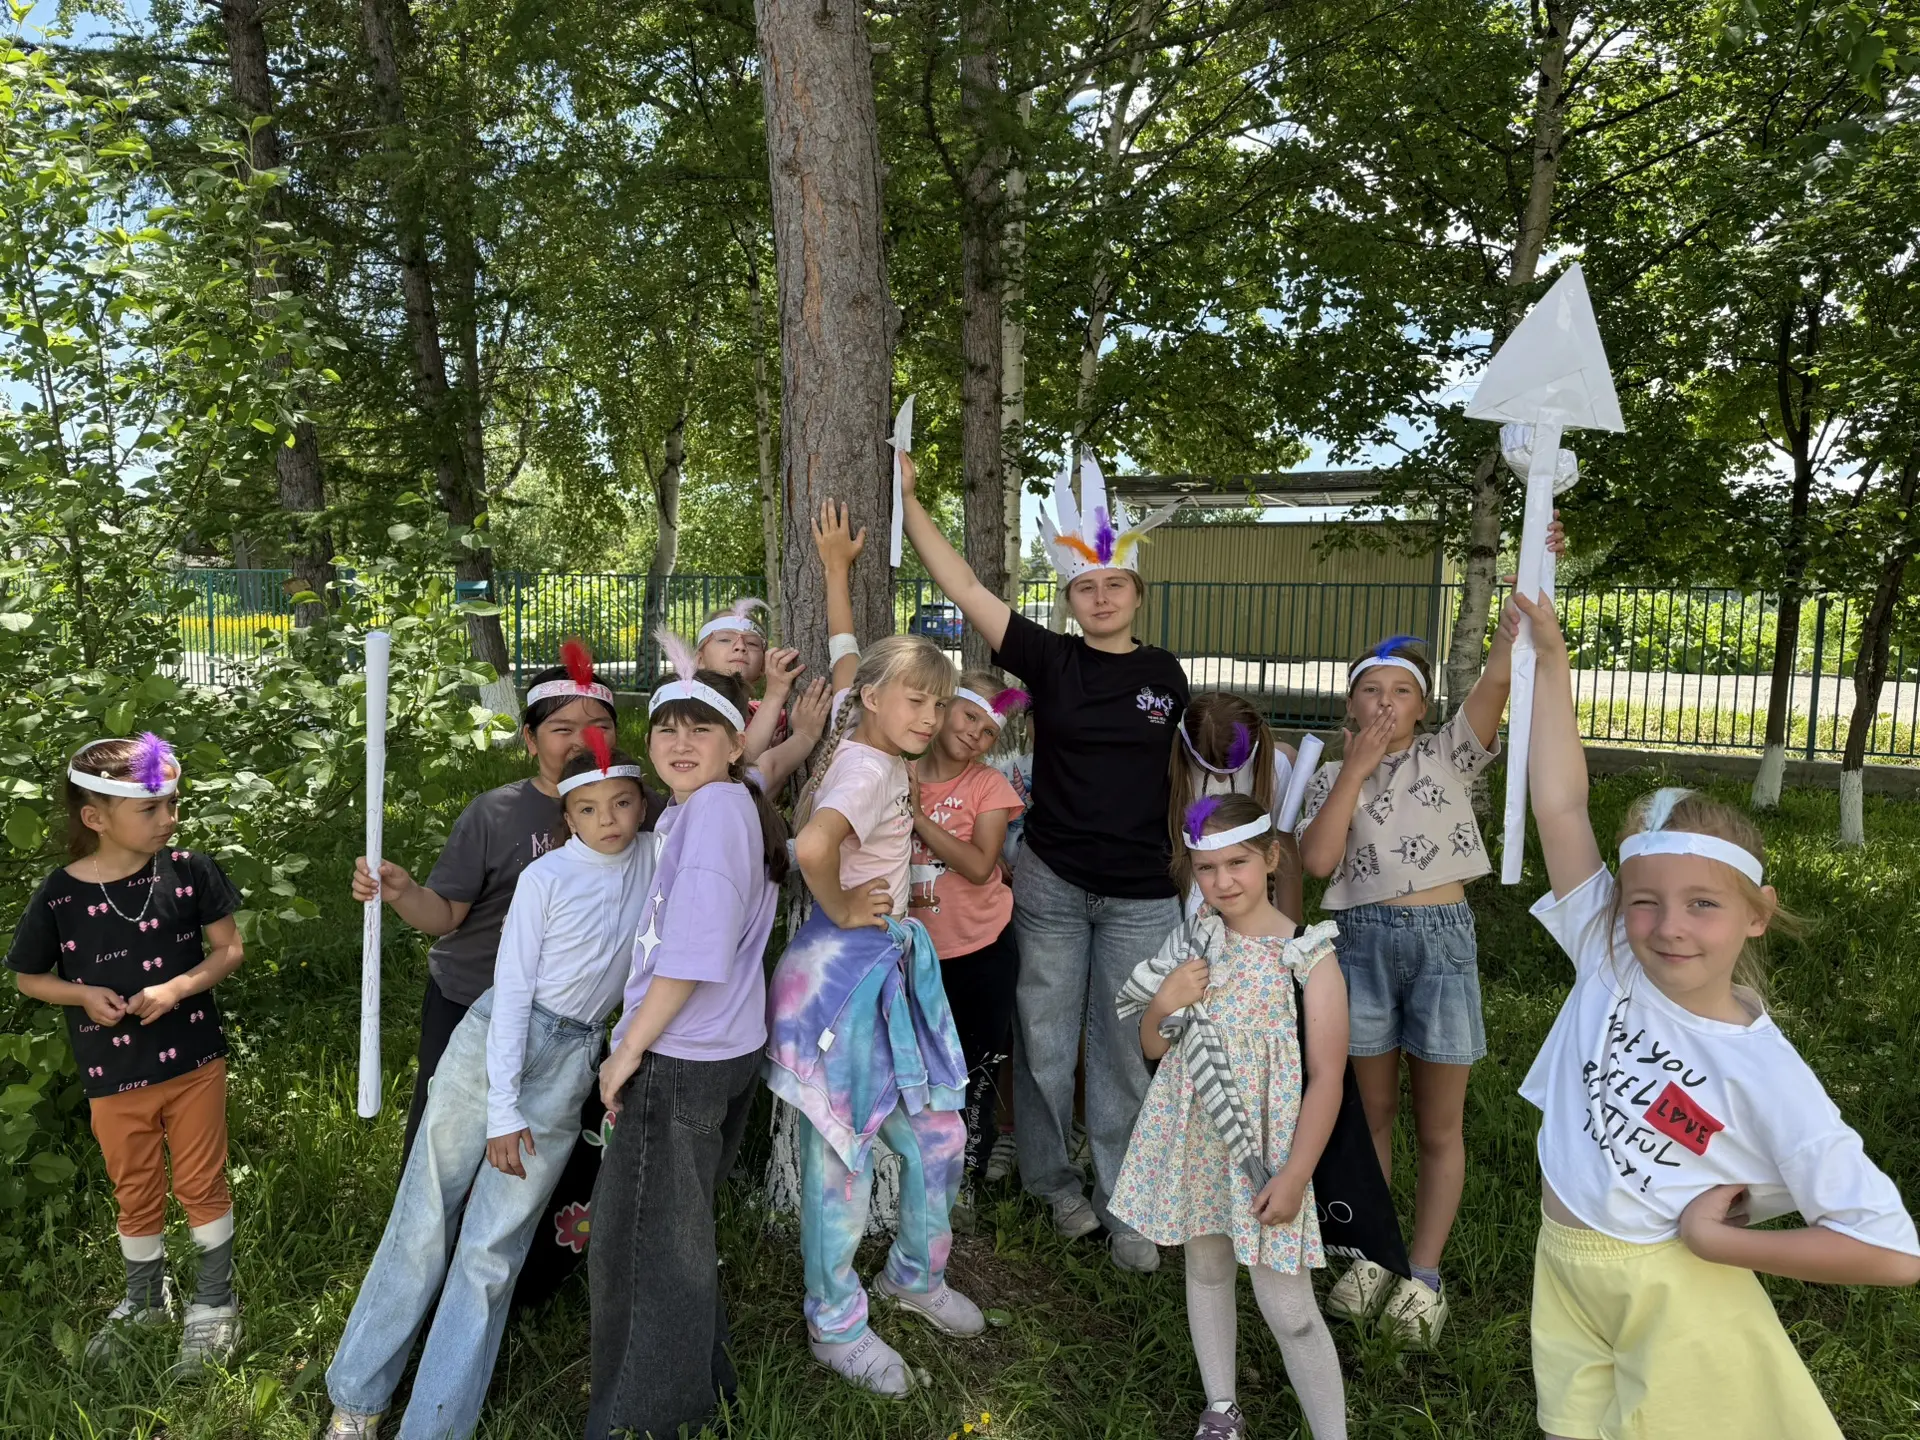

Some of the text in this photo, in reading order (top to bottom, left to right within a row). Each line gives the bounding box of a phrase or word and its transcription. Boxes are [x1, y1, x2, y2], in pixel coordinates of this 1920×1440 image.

[126, 875, 161, 888] Love
[175, 931, 195, 943] Lov
[95, 947, 128, 963] Love
[79, 1024, 101, 1033] Love
[118, 1078, 149, 1093] Love
